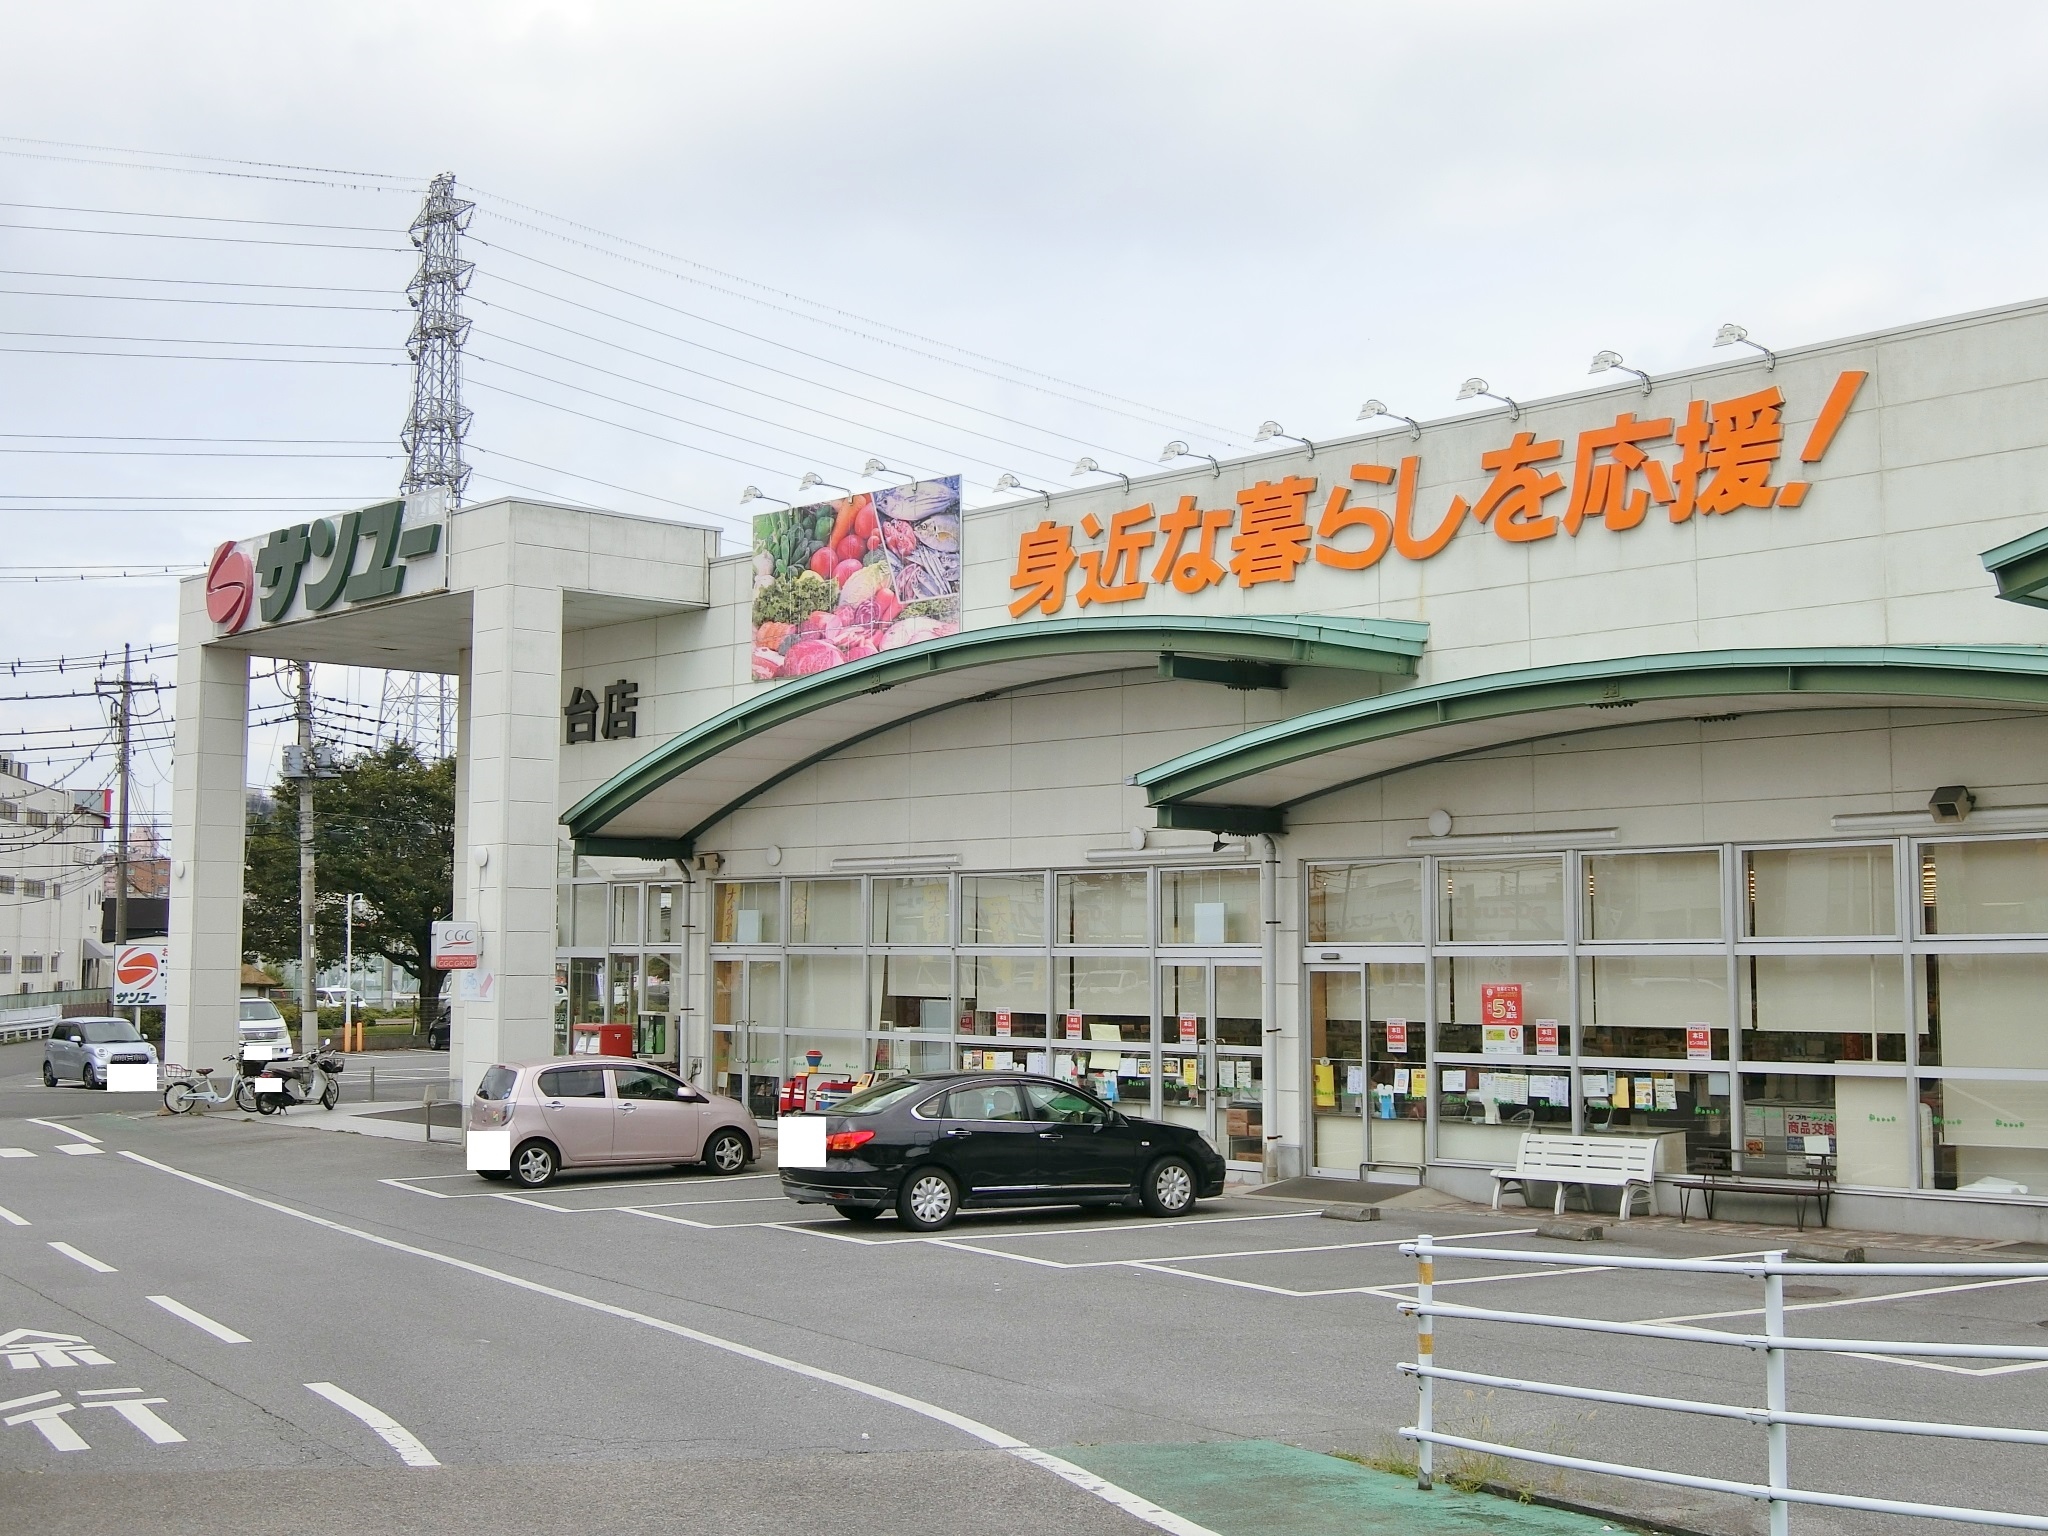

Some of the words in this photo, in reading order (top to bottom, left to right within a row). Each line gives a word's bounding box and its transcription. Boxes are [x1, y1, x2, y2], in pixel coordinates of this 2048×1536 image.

[255, 500, 442, 622] サンユー
[445, 929, 474, 942] CGC
[116, 992, 158, 1004] サンユー
[1788, 1121, 1835, 1135] 商品交換
